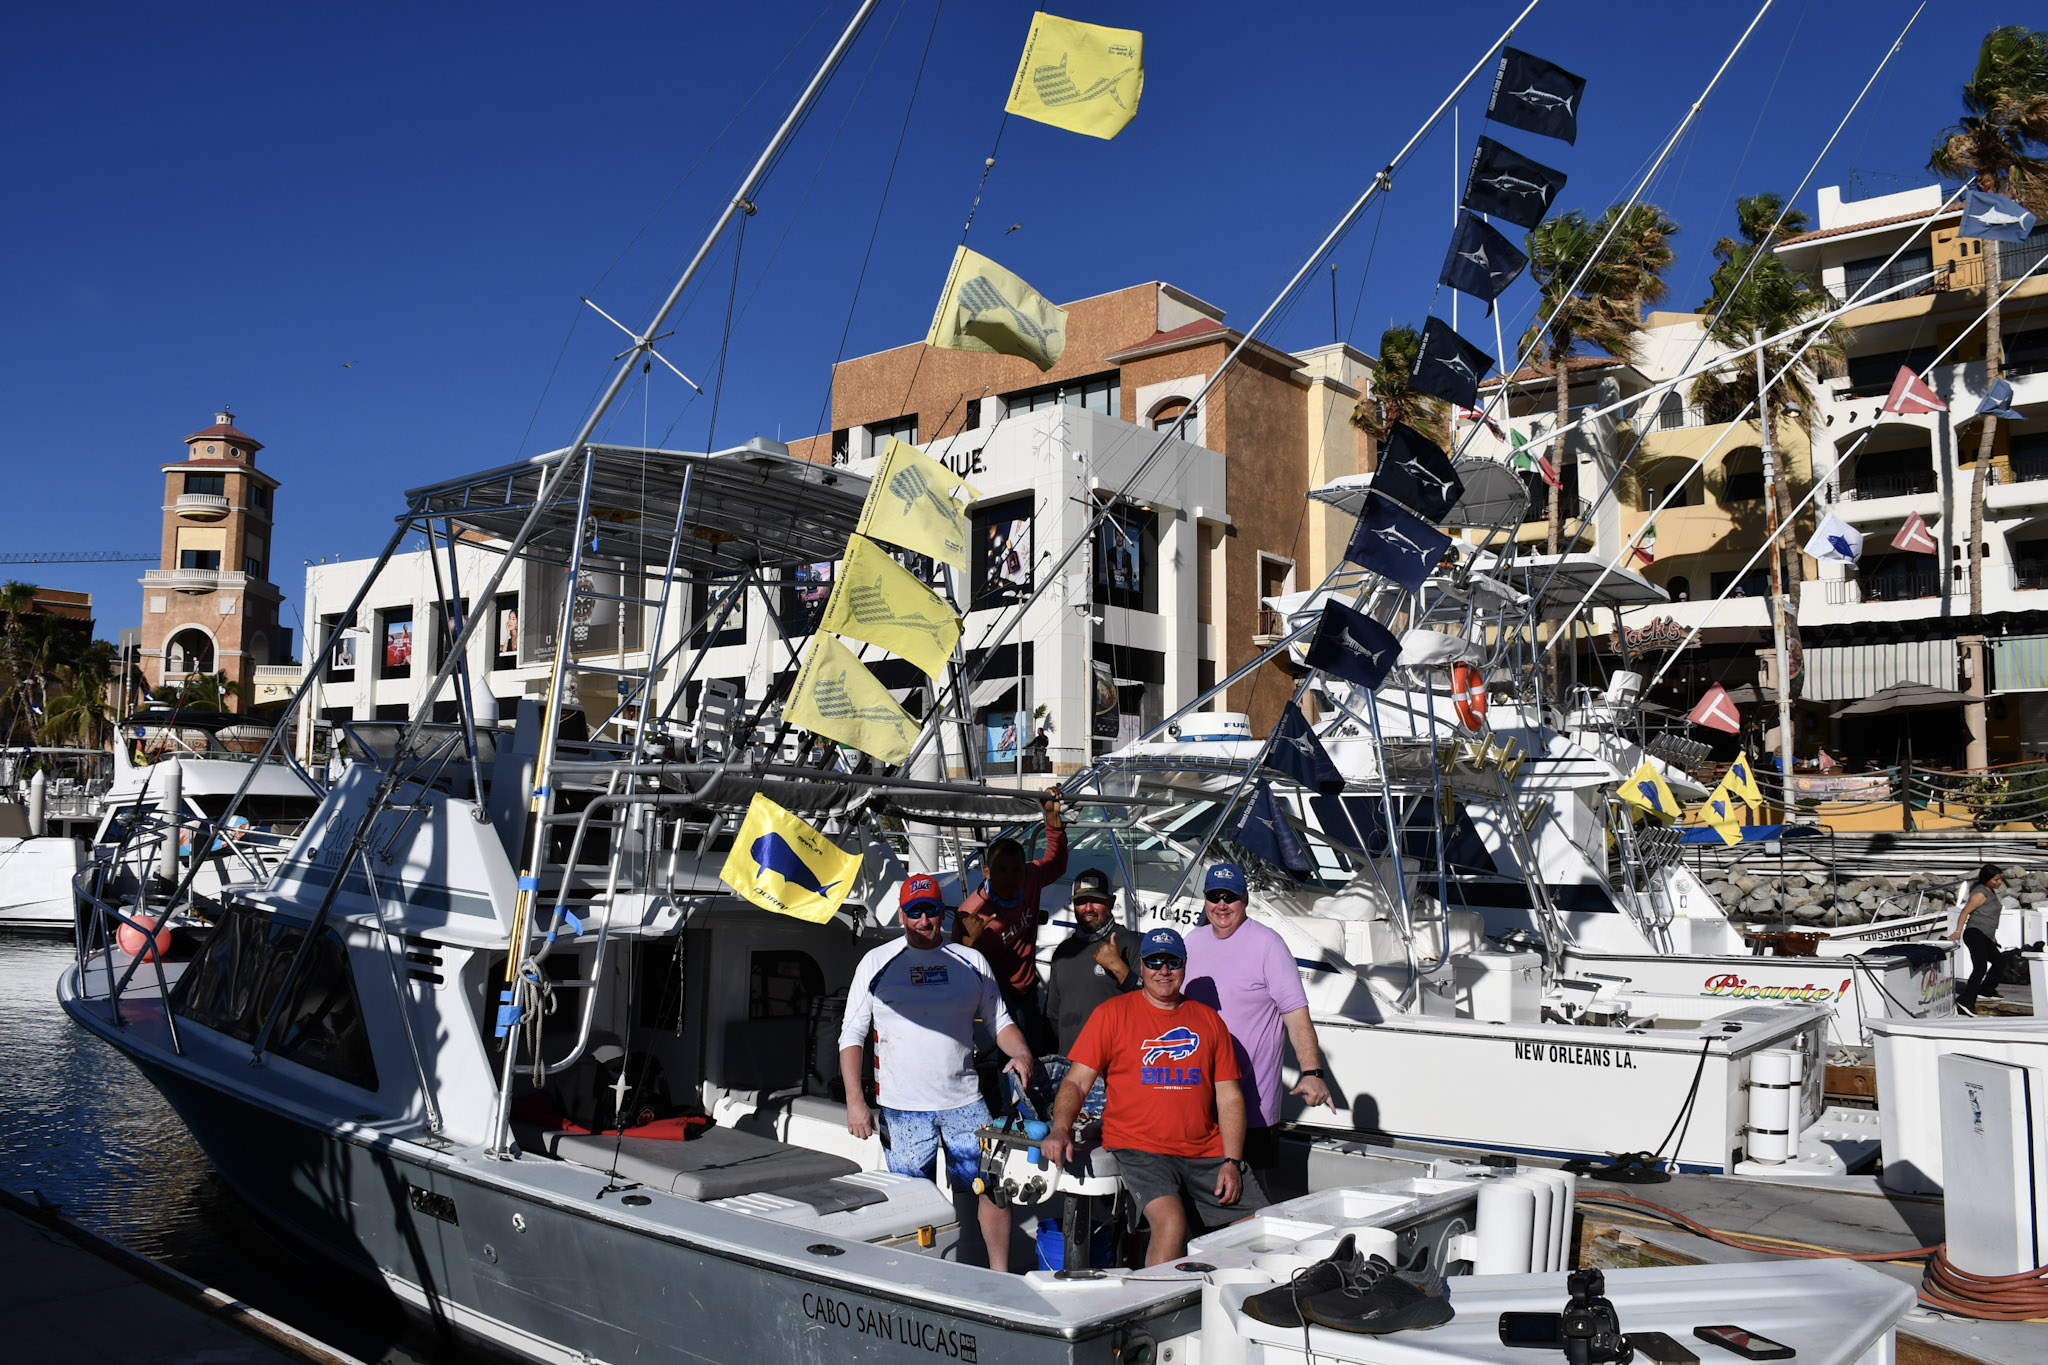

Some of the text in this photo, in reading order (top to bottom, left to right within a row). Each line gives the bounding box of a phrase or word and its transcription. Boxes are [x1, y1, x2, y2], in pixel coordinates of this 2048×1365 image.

[1515, 1042, 1637, 1069] NEW ORLEANS LA.
[1141, 1066, 1202, 1085] BILLS
[802, 1292, 959, 1358] CABO SAN LUCAS
